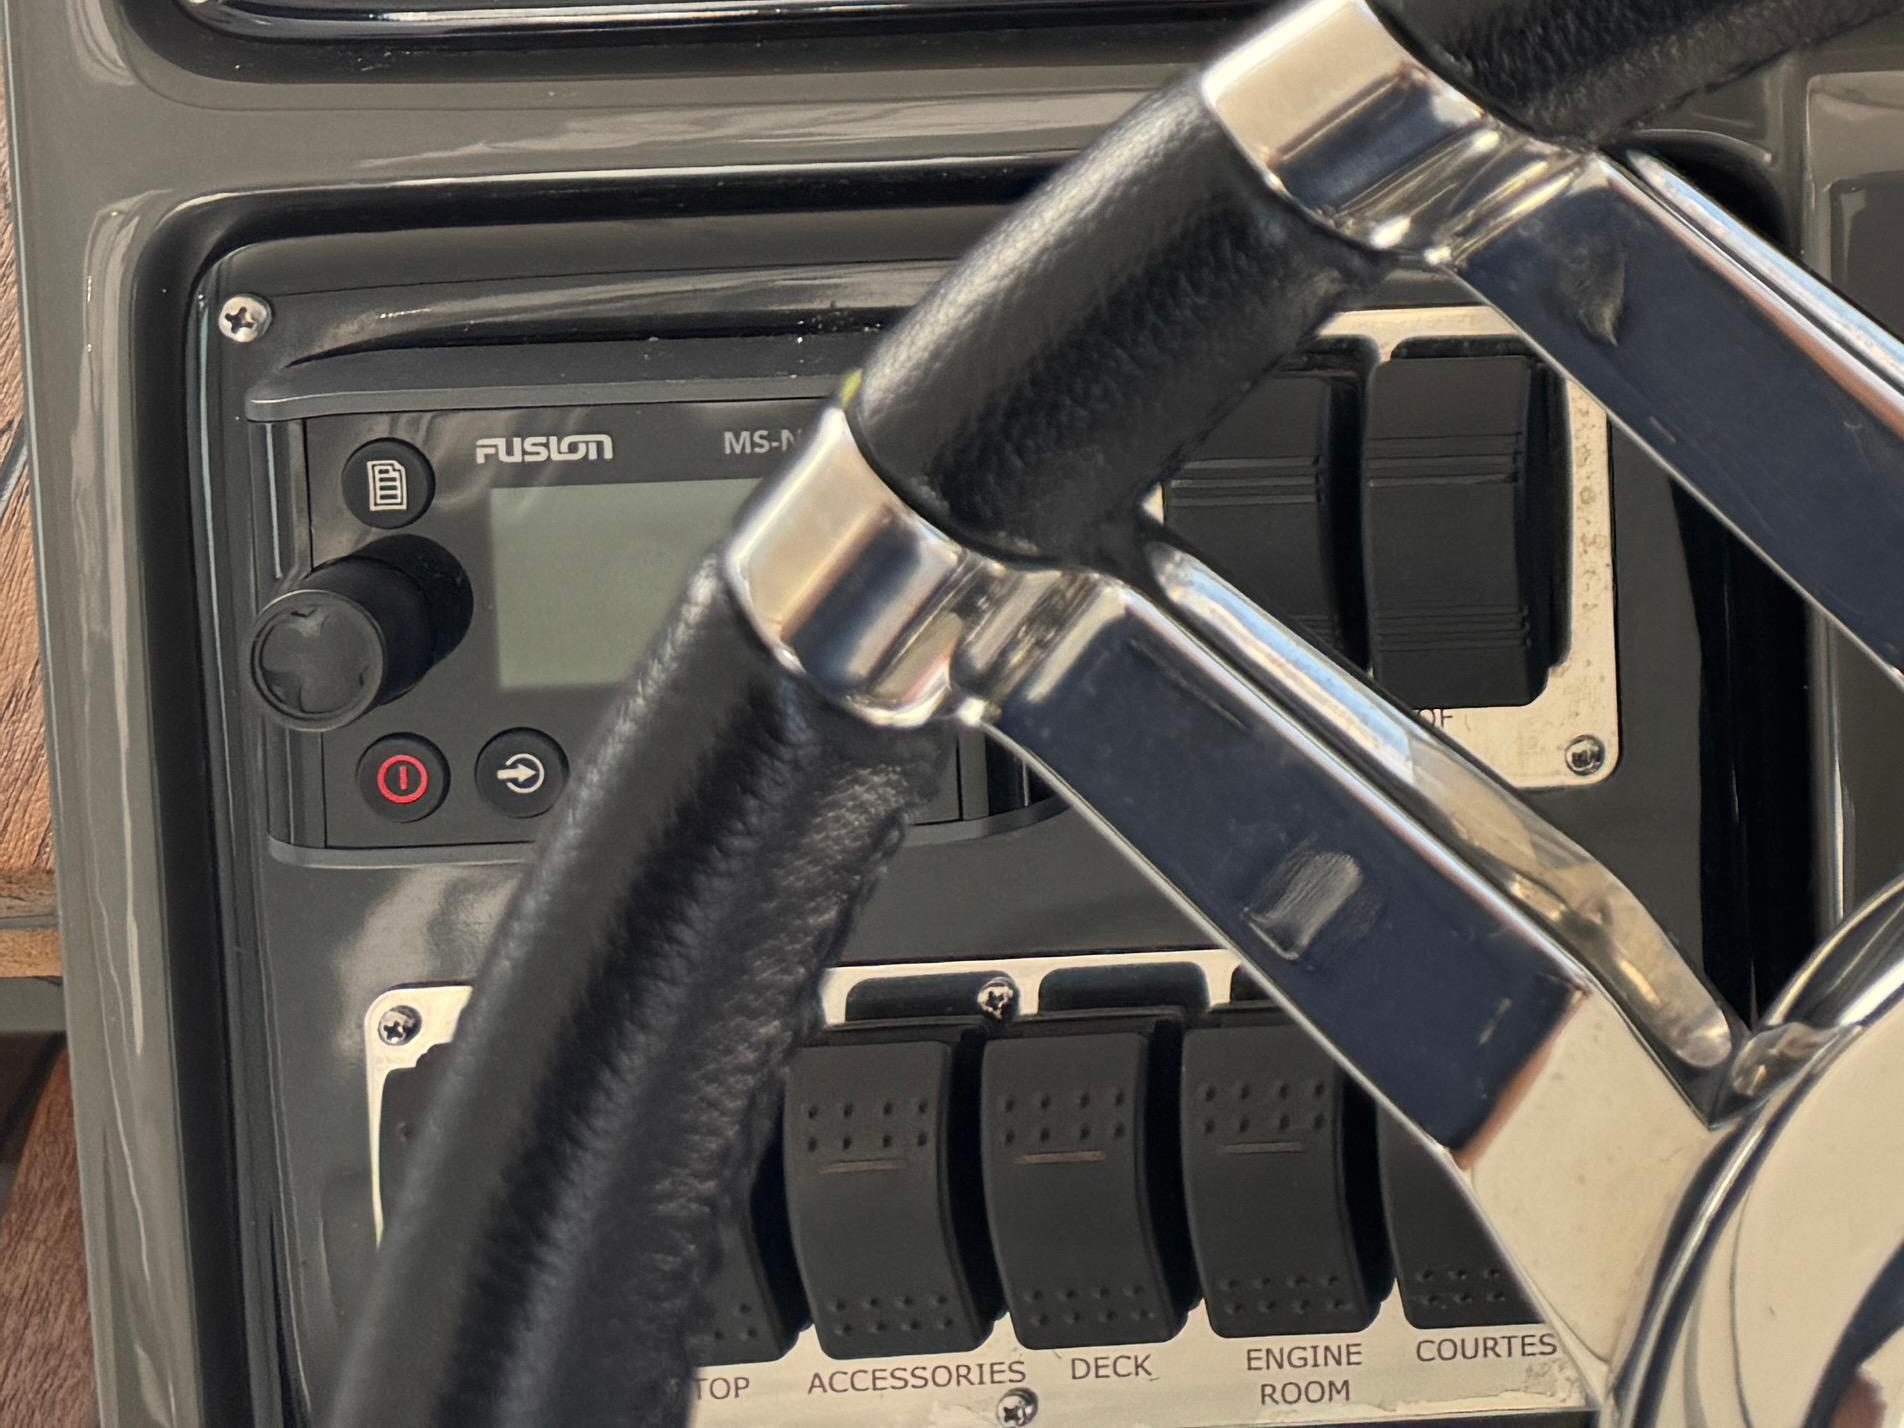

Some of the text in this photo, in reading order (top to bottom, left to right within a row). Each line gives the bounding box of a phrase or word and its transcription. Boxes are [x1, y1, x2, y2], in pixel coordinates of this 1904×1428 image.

[475, 433, 614, 464] FUSION
[1246, 1342, 1363, 1372] ENGINE
[1416, 1333, 1558, 1362] COURTES
[808, 1360, 1027, 1395] ACCESSORIES
[1070, 1353, 1153, 1381] DECK
[1259, 1380, 1351, 1406] ROOM
